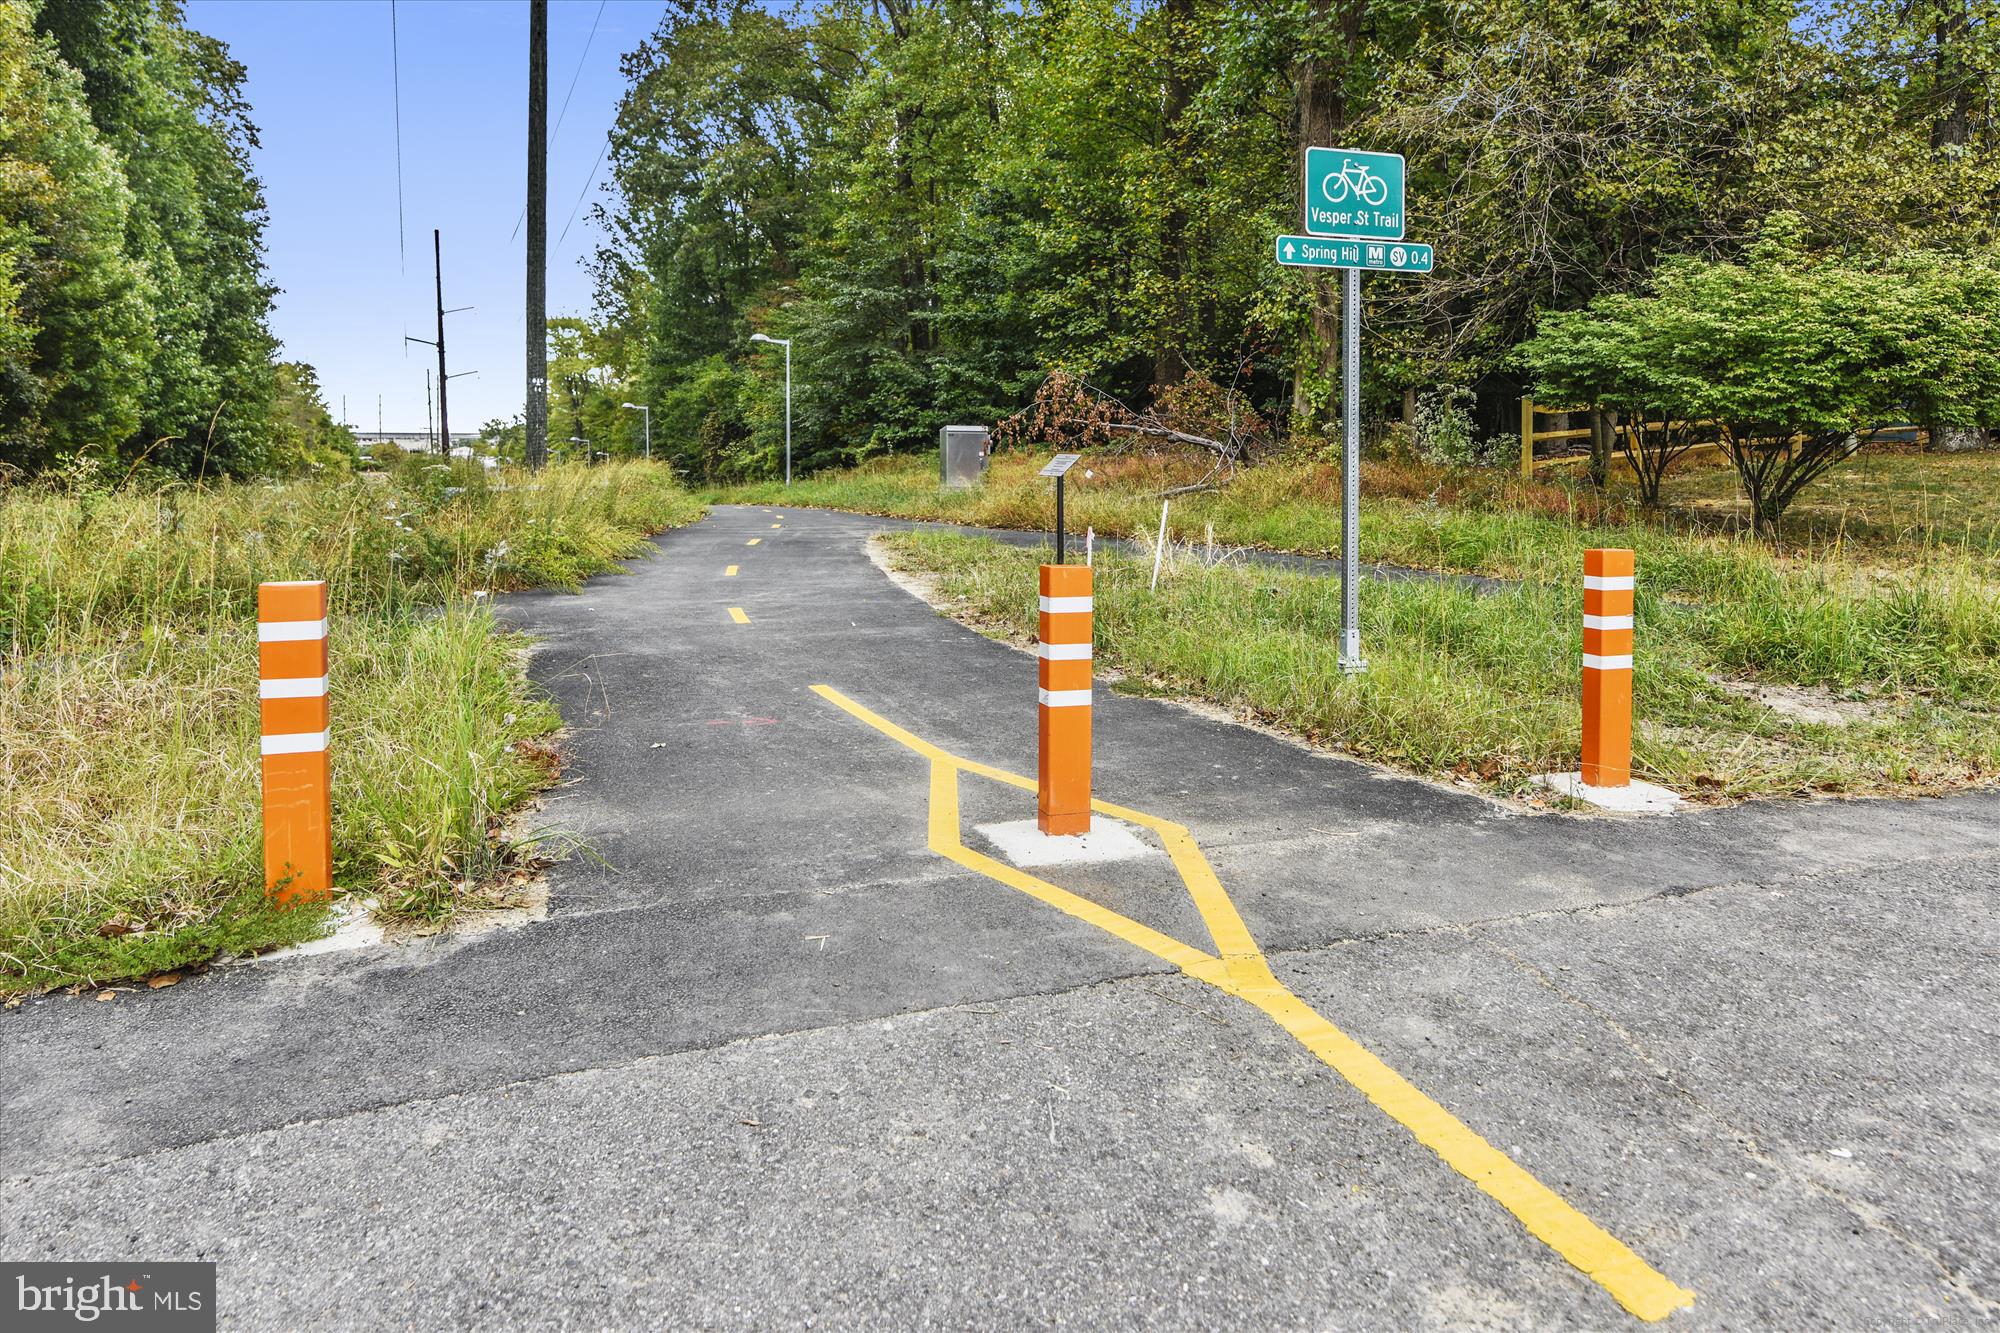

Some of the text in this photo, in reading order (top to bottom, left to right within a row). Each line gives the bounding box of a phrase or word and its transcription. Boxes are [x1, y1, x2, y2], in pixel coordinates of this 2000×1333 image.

[1311, 207, 1399, 228] Vesper St Trail
[1302, 244, 1337, 263] Spring
[1369, 246, 1383, 259] M
[1392, 250, 1405, 262] SV
[1411, 251, 1428, 265] 0.4
